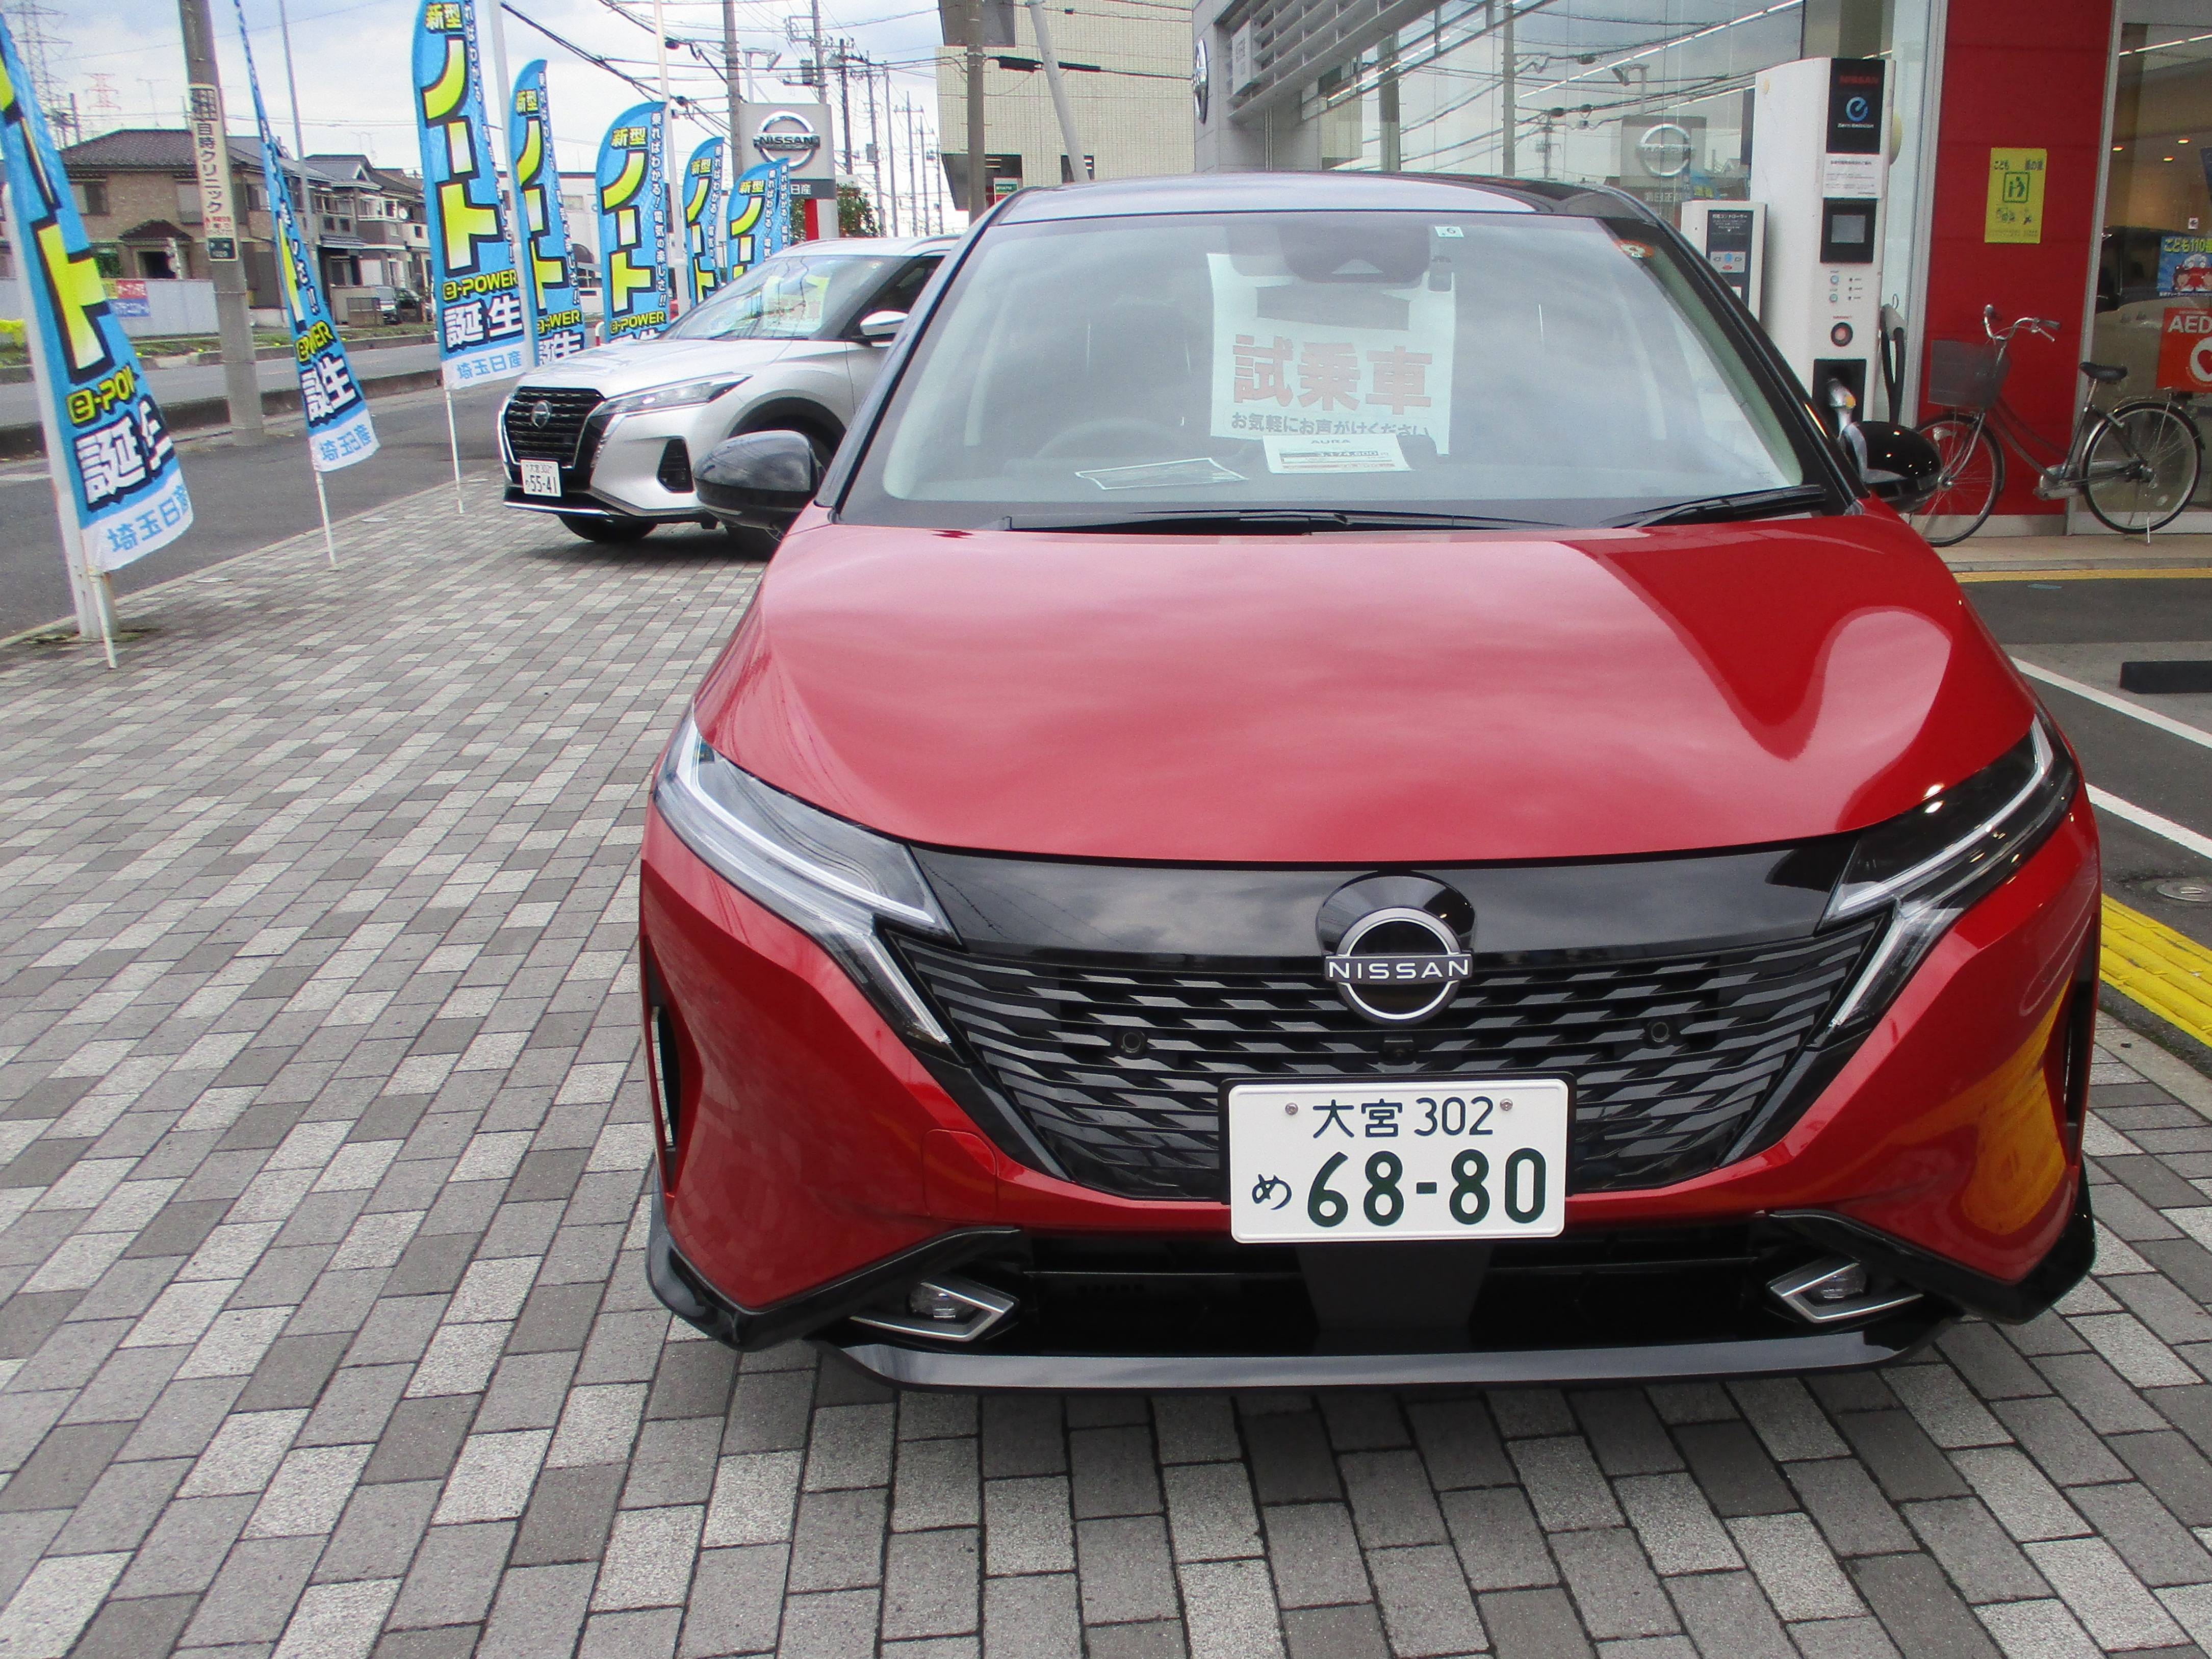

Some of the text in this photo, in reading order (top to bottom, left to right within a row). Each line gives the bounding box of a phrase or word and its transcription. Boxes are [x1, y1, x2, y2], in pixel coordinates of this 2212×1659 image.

[425, 3, 463, 31] 新型
[516, 90, 538, 113] 新型
[611, 127, 647, 147] 新型
[759, 137, 813, 145] NISSAN
[423, 39, 499, 270] ノート
[691, 158, 711, 176] 新型
[739, 179, 764, 194] 新型
[791, 184, 811, 195] 日産
[603, 152, 651, 313] ノート
[443, 270, 518, 302] e-POWER
[444, 294, 523, 349] 誕生
[610, 310, 665, 334] e-POWER
[2168, 314, 2212, 333] AED
[457, 350, 522, 379] 埼玉日産
[1233, 334, 1432, 416] 試乗車
[1231, 411, 1429, 437] お気軽にお声がけください
[530, 474, 557, 494] 55-41
[1329, 960, 1469, 979] NISSAN
[1252, 1147, 1547, 1228] め 68-80
